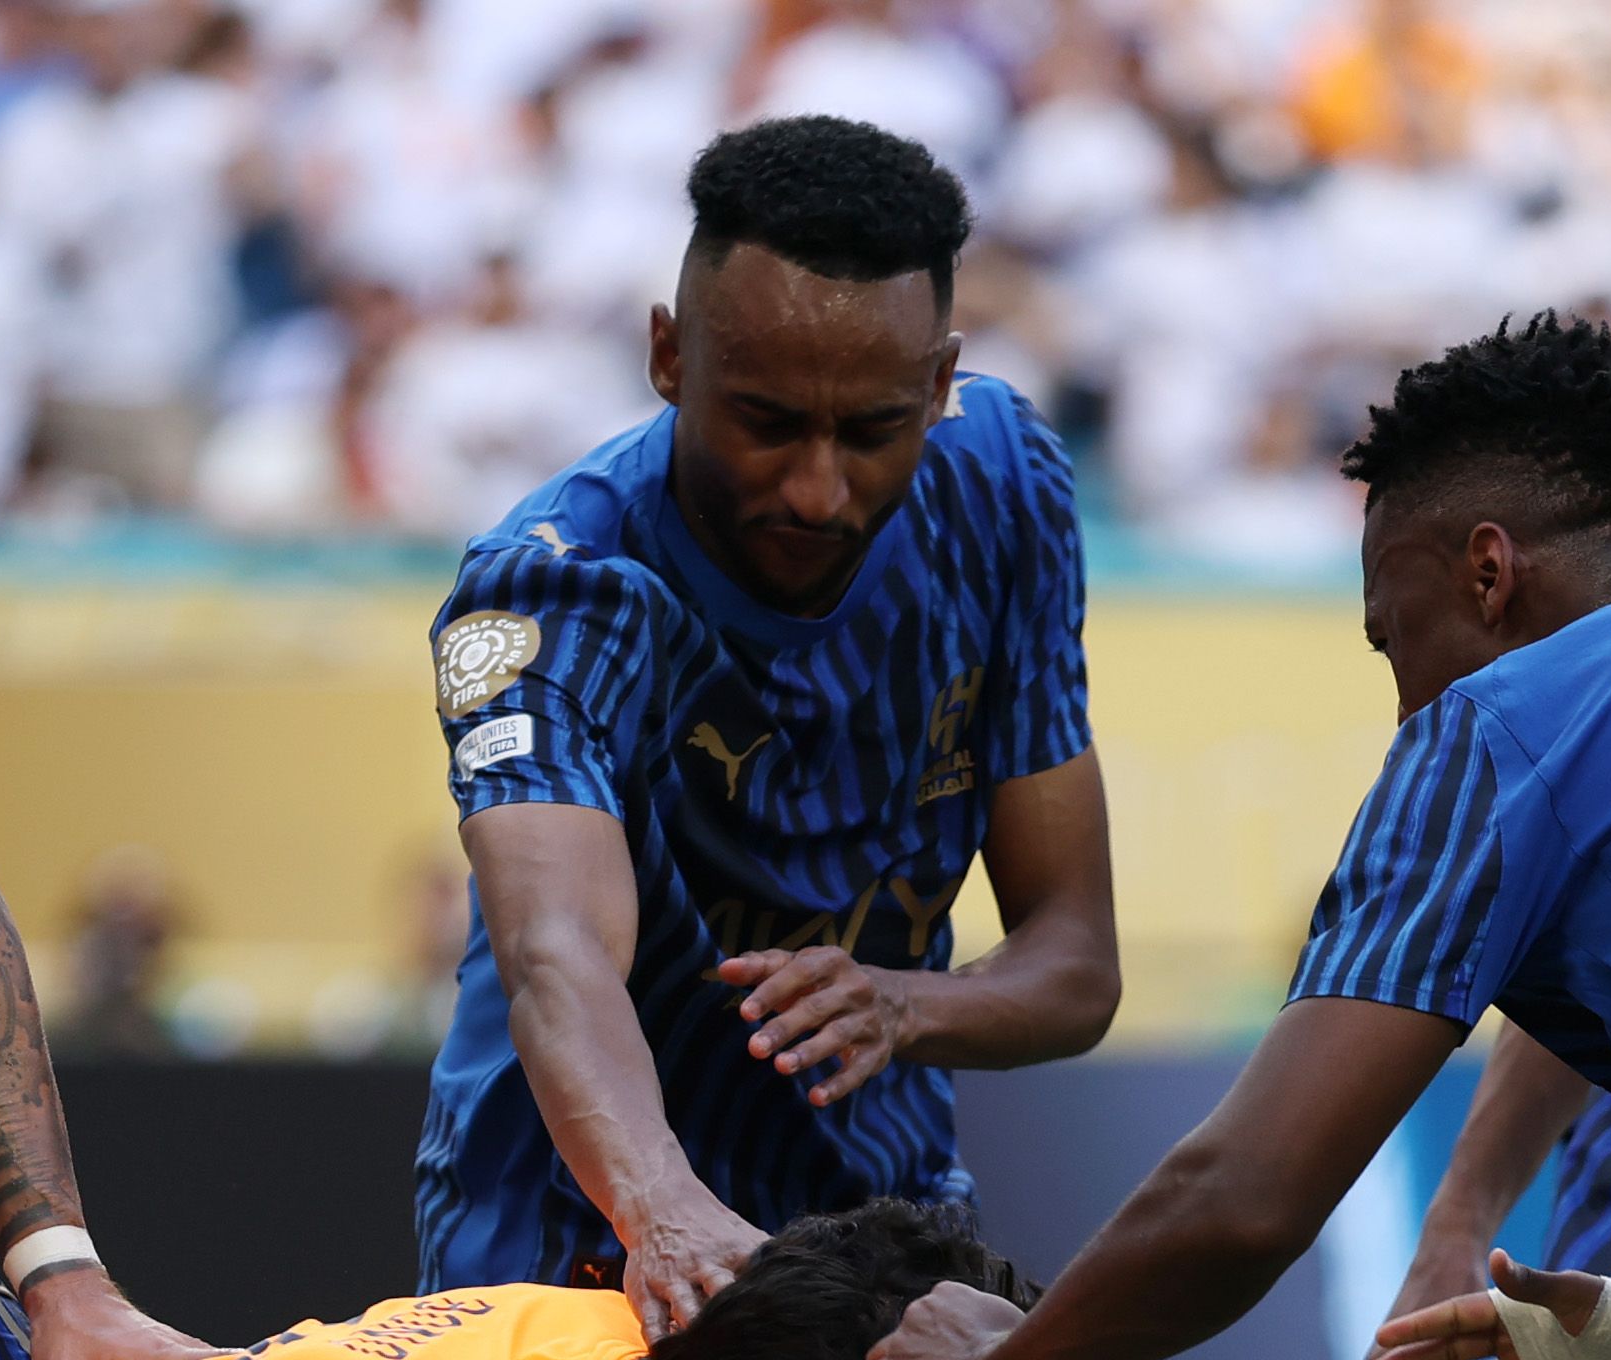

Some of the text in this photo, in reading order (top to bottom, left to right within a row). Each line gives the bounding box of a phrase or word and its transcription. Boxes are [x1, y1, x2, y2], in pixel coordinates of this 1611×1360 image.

[442, 619, 493, 657] WORLD
[451, 681, 489, 711] FIFA
[480, 720, 518, 742] UNITES
[491, 739, 517, 755] FIFA
